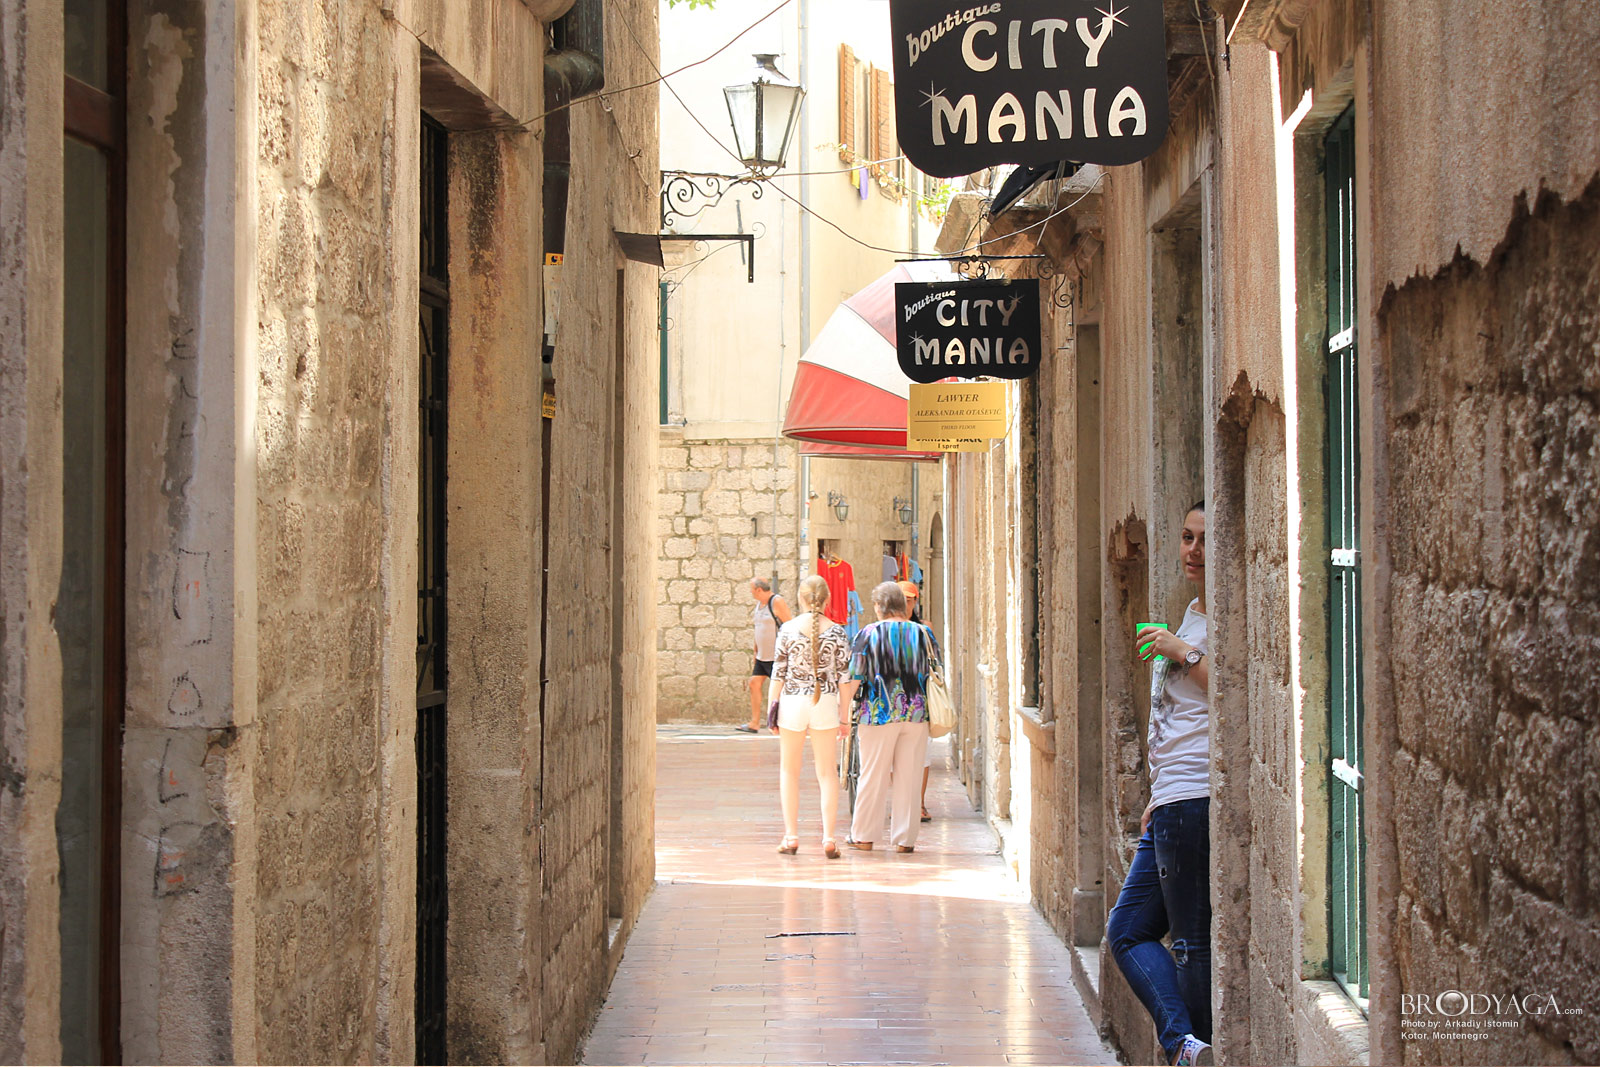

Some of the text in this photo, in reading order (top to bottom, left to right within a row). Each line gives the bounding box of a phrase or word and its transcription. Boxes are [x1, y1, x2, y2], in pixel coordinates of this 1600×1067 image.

[906, 2, 1001, 67] boutique
[961, 17, 1113, 72] CITY
[931, 85, 1147, 146] MANIA
[904, 289, 956, 323] boutique
[936, 299, 1018, 327] CITY
[914, 337, 1030, 366] MANIA
[915, 409, 964, 417] ALEKSANDAR
[937, 394, 979, 403] LAWYER
